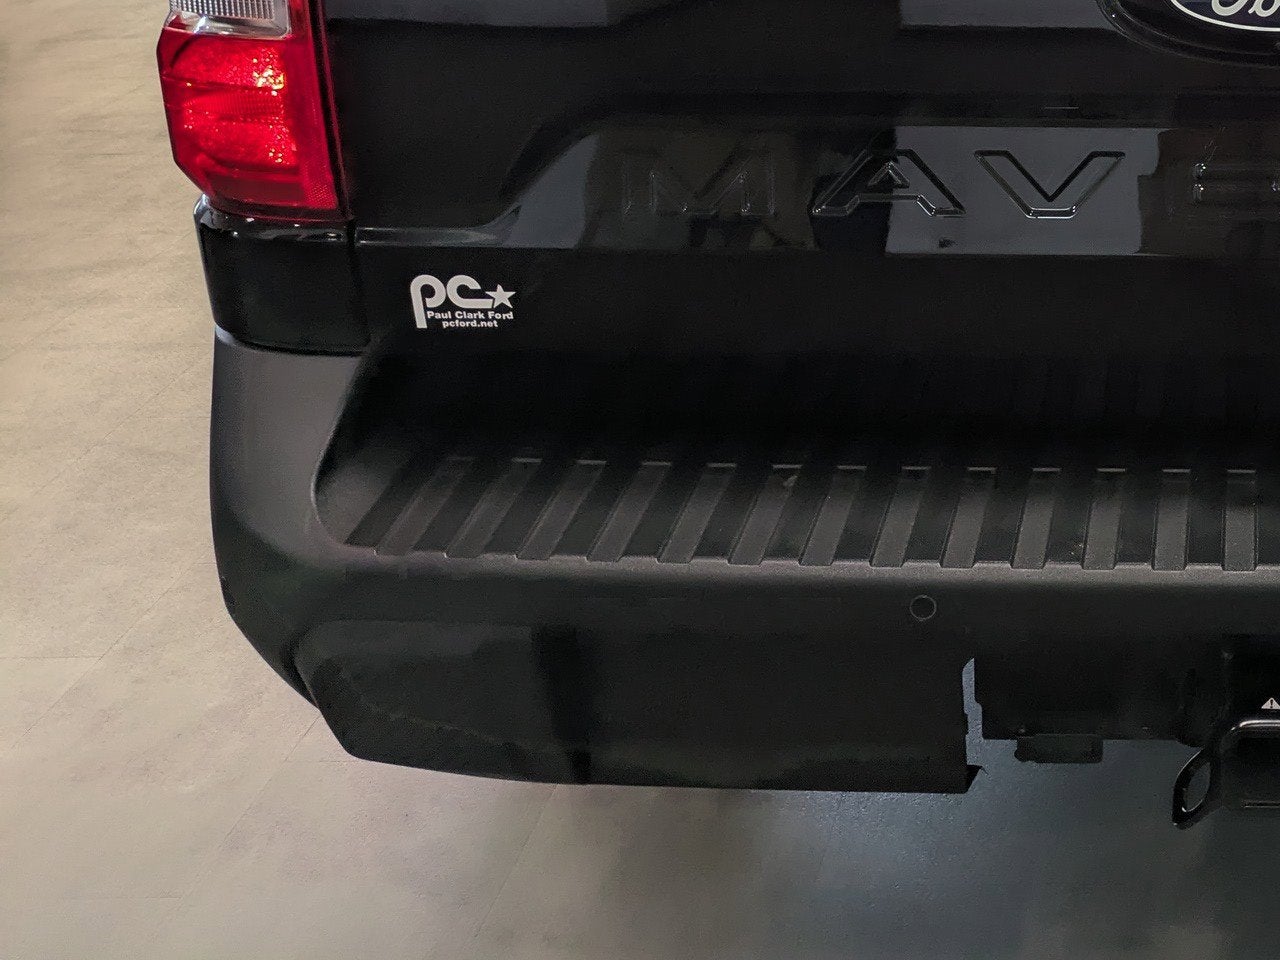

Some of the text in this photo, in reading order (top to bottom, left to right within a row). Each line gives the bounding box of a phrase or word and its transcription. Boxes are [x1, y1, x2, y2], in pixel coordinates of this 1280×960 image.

[427, 311, 514, 320] Paul Clark Ford
[442, 320, 498, 328] pcford.net
